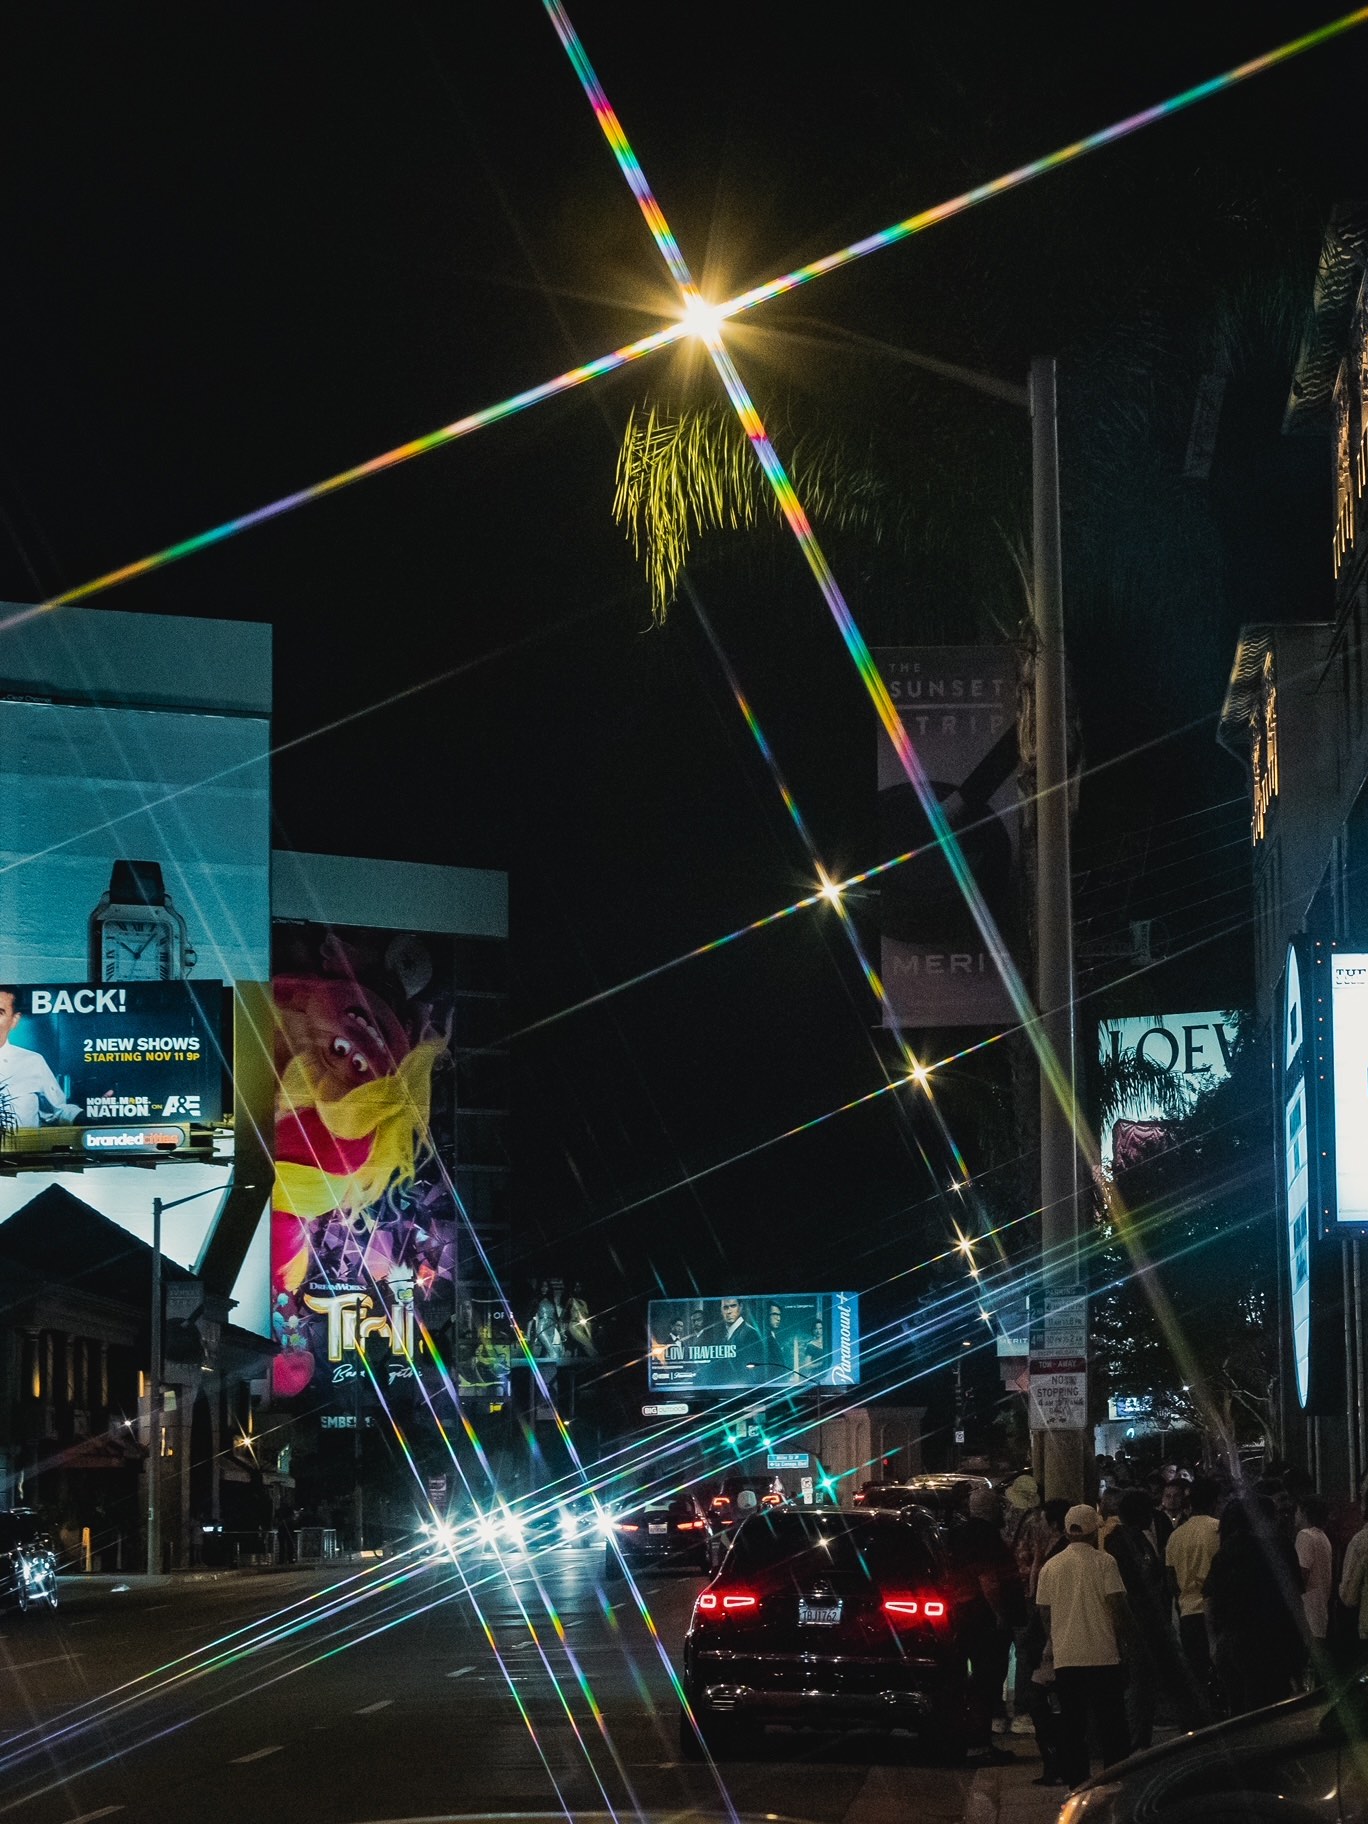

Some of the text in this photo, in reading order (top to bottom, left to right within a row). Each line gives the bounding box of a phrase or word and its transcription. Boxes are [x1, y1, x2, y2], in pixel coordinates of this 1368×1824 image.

[889, 663, 920, 673] THE
[890, 679, 1004, 698] SUNSET
[893, 952, 1008, 975] MERI
[32, 989, 127, 1014] BACK!
[84, 1037, 200, 1051] 2 NEW SHOWS
[84, 1052, 200, 1062] STARTING NOV 11 9P
[162, 1096, 201, 1116] A&E
[688, 1345, 737, 1360] TRAVELERS
[1051, 1375, 1064, 1385] NO
[1037, 1387, 1079, 1397] STOPPING
